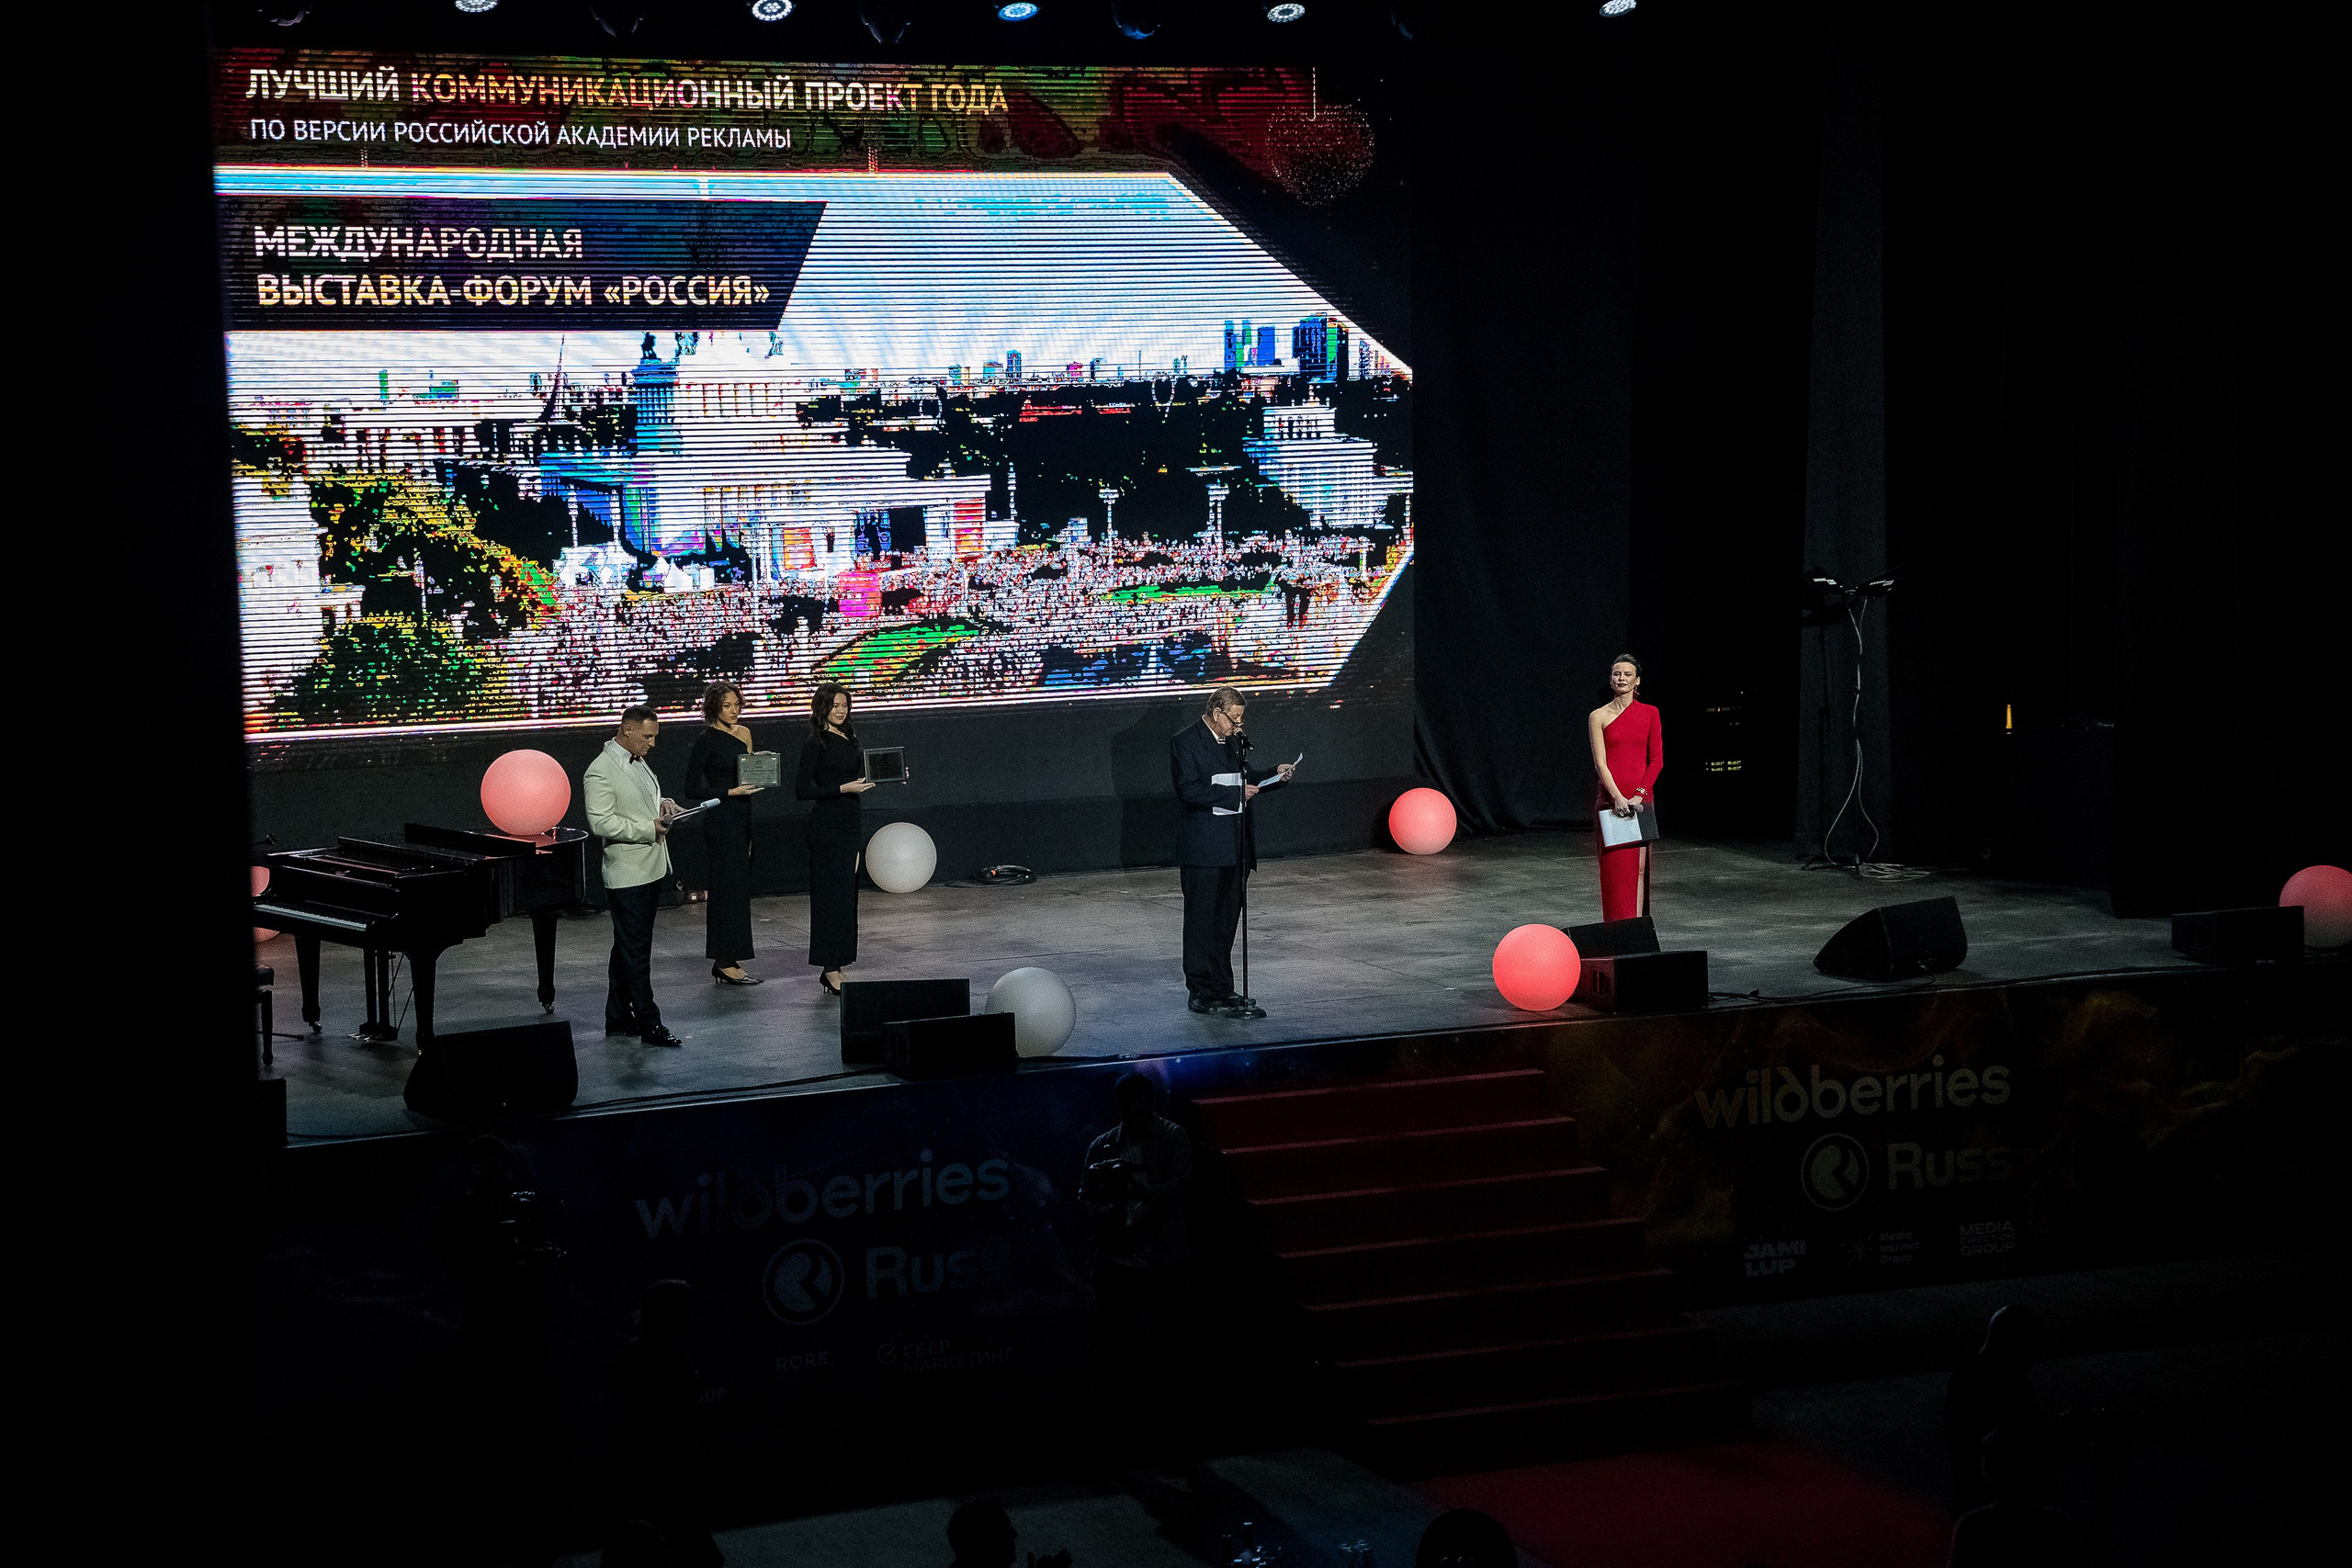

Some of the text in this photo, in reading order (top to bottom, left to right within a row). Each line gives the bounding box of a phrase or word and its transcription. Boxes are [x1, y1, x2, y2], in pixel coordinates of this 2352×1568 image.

[245, 65, 1009, 116] ЛУЧШИЙ КОММУНИКАЦИОННЫЙ ПРОЕКТ ГОДА
[251, 118, 791, 150] ПО ВЕРСИИ РОССИЙСКОЙ АКАДЕМИИ РЕКЛАМЫ
[254, 226, 583, 262] МЕЖДУНАРОДНАЯ
[257, 274, 770, 307] ВЫСТАВКА-ФОРУМ «РОССИЯ»
[1695, 1054, 2011, 1129] wildberries
[1886, 1141, 2013, 1190] Russ
[635, 1148, 1012, 1239] wildberries
[1959, 1220, 2015, 1236] MEDIA
[1961, 1241, 2016, 1257] GROUP
[1746, 1258, 1797, 1278] LUP
